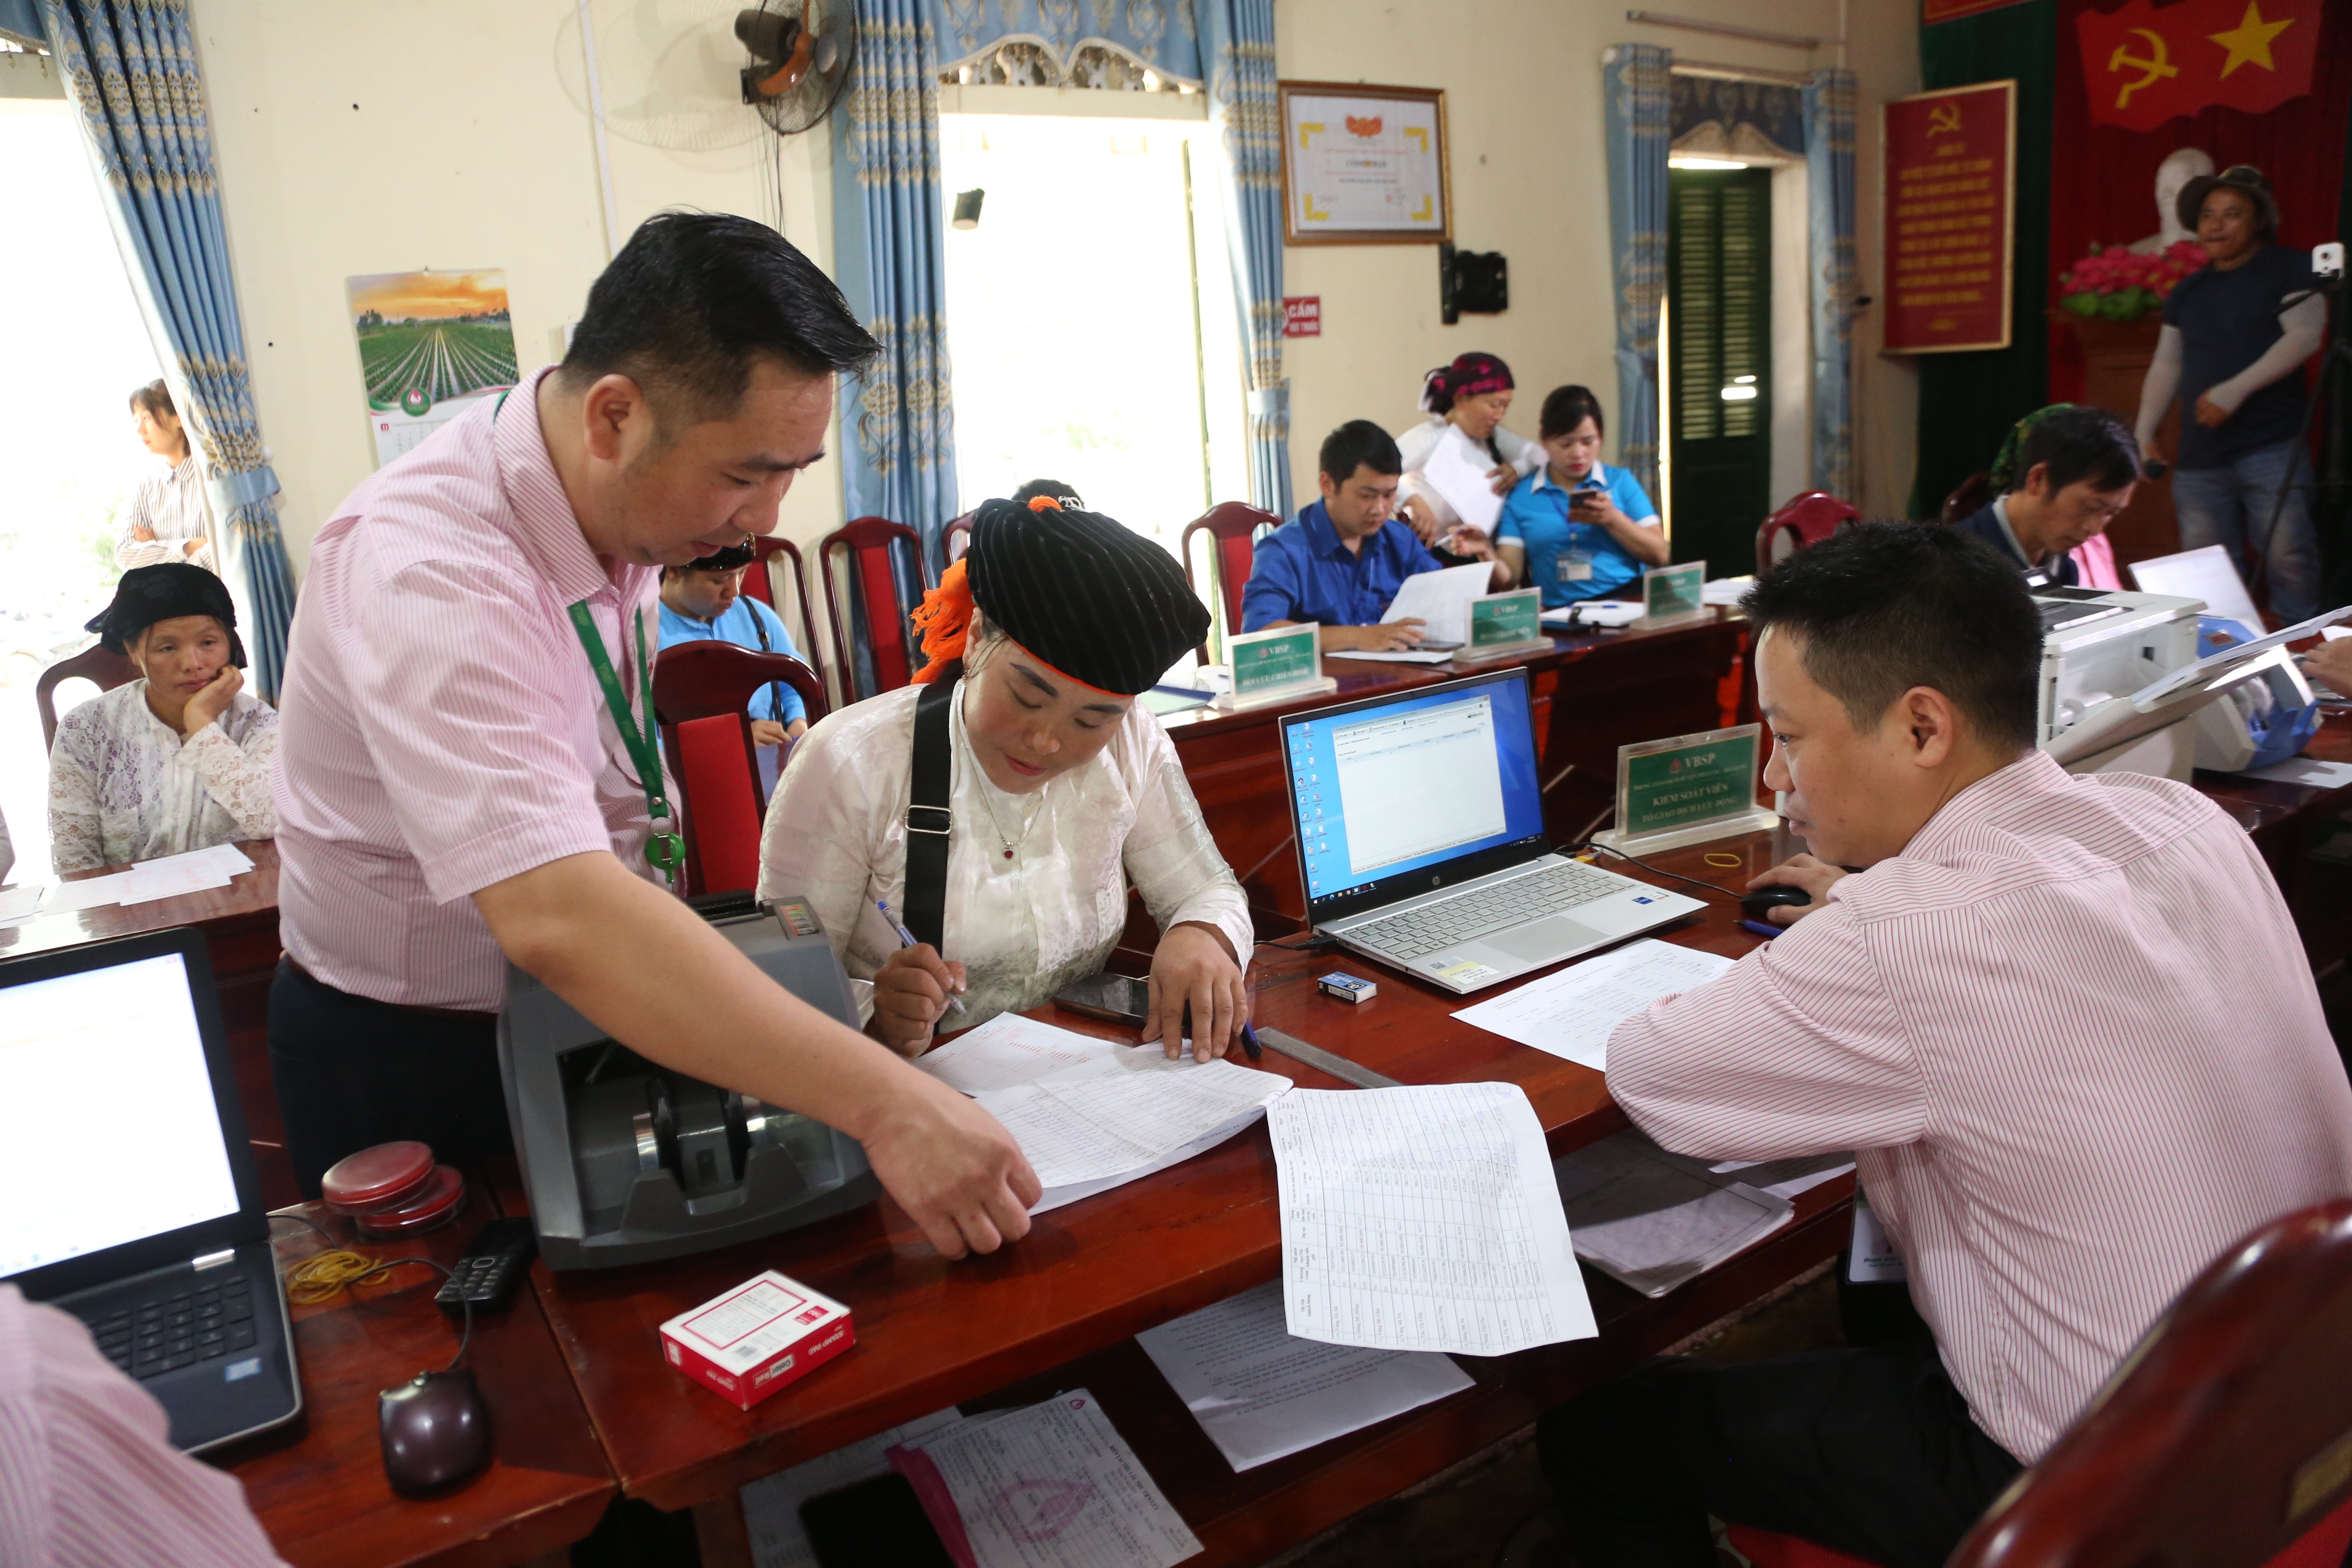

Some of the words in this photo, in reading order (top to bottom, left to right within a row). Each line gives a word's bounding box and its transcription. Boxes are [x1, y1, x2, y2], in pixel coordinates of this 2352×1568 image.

[1288, 299, 1316, 318] CẤM
[1269, 644, 1289, 654] VBSP
[1685, 753, 1716, 767] VBSP
[822, 1330, 844, 1347] STAMP
[808, 1343, 822, 1355] PAD
[772, 1359, 791, 1374] Color
[755, 1371, 771, 1385] Red
